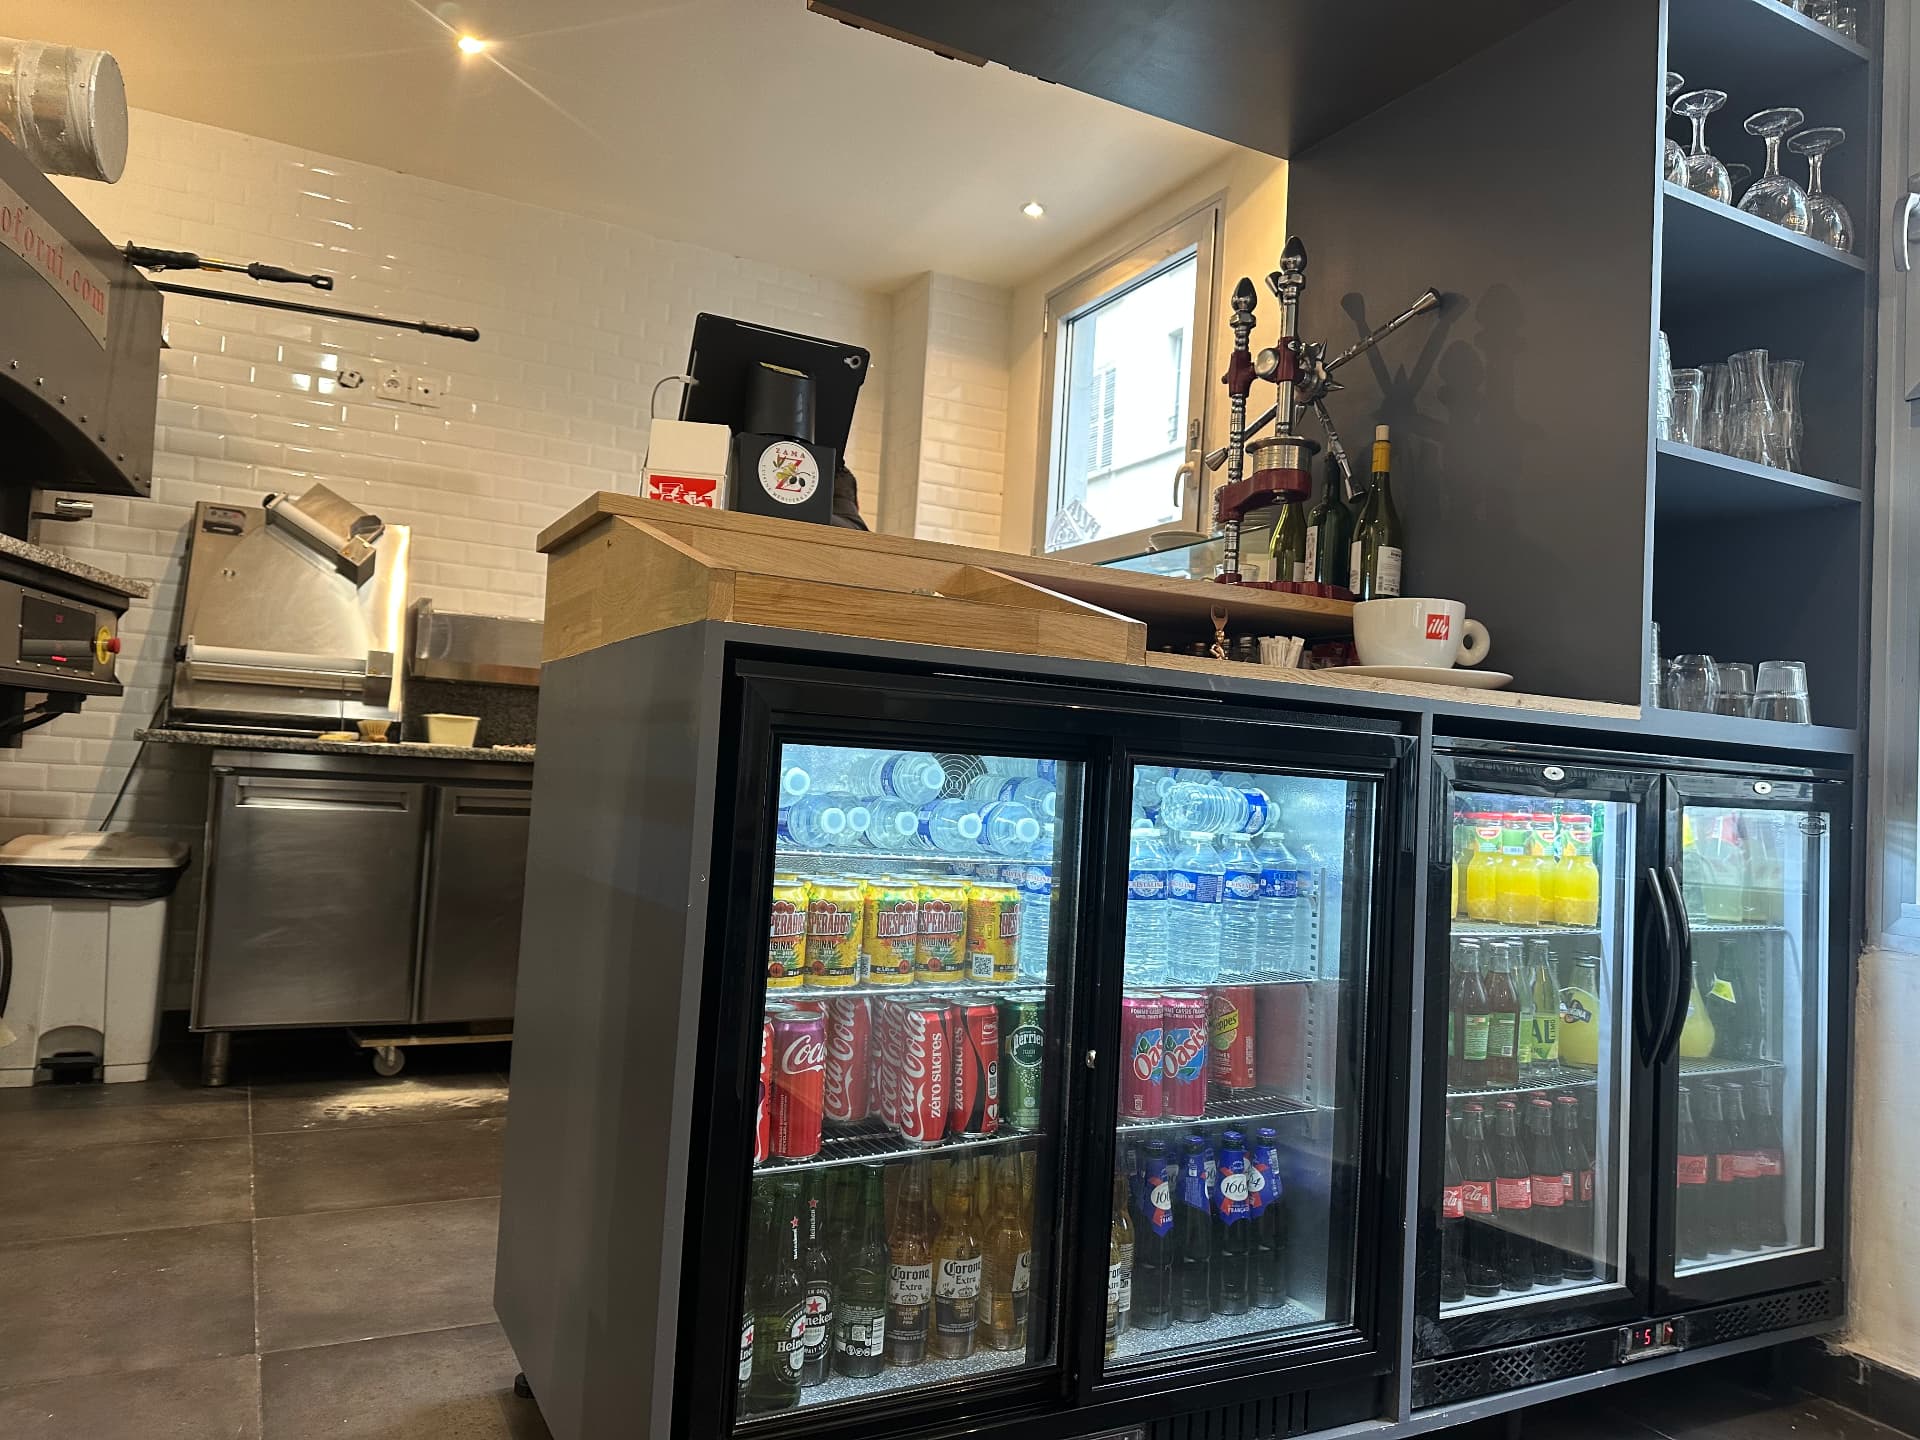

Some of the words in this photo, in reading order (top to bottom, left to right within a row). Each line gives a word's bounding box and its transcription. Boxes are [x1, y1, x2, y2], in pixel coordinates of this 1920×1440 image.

[776, 447, 806, 459] ZAMA
[1427, 618, 1449, 639] illy
[931, 1032, 942, 1082] sucres
[929, 1082, 942, 1118] zéro
[890, 1266, 930, 1281] Corona
[899, 1280, 923, 1291] Extra
[804, 1311, 834, 1328] neken
[776, 1338, 805, 1353] Hein
